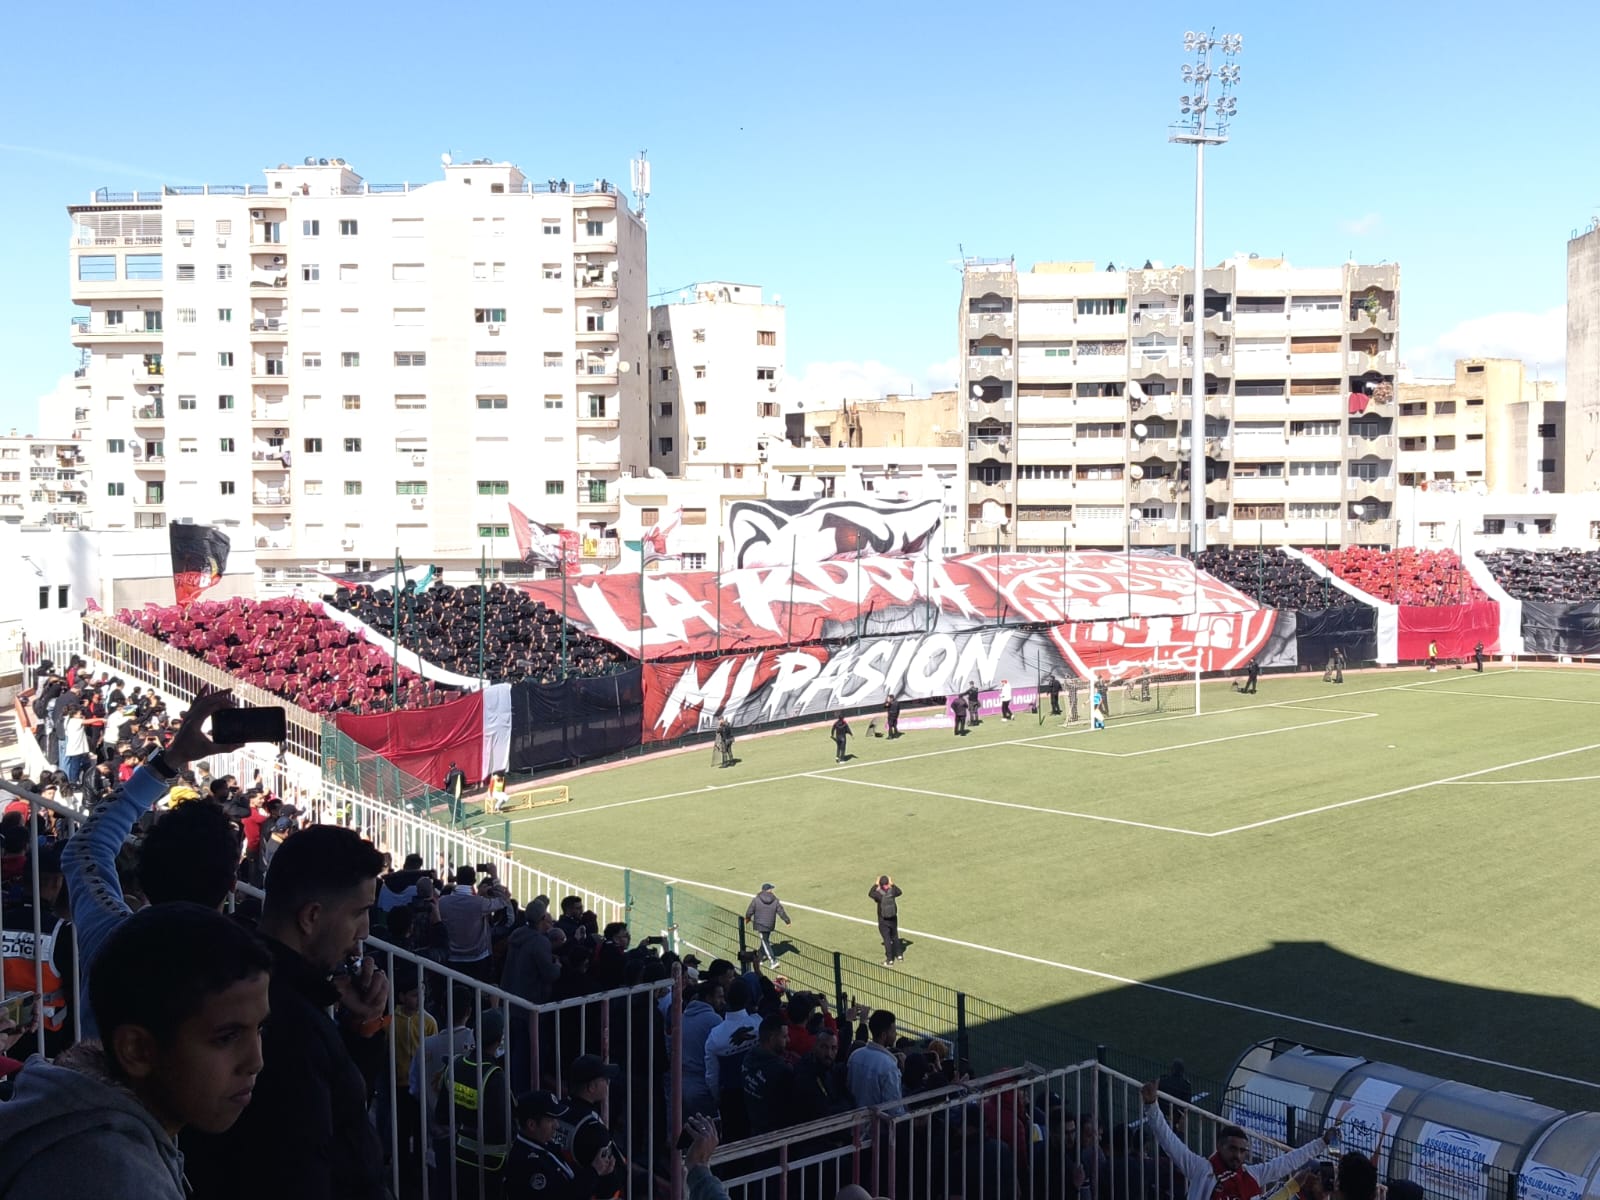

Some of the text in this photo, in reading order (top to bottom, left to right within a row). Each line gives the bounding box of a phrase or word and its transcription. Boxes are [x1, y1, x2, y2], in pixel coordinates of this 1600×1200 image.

[573, 577, 726, 650] LA
[654, 630, 1014, 737] MI PASION
[2, 944, 36, 955] OLIC
[1424, 1137, 1486, 1163] ASSURANCES 2M
